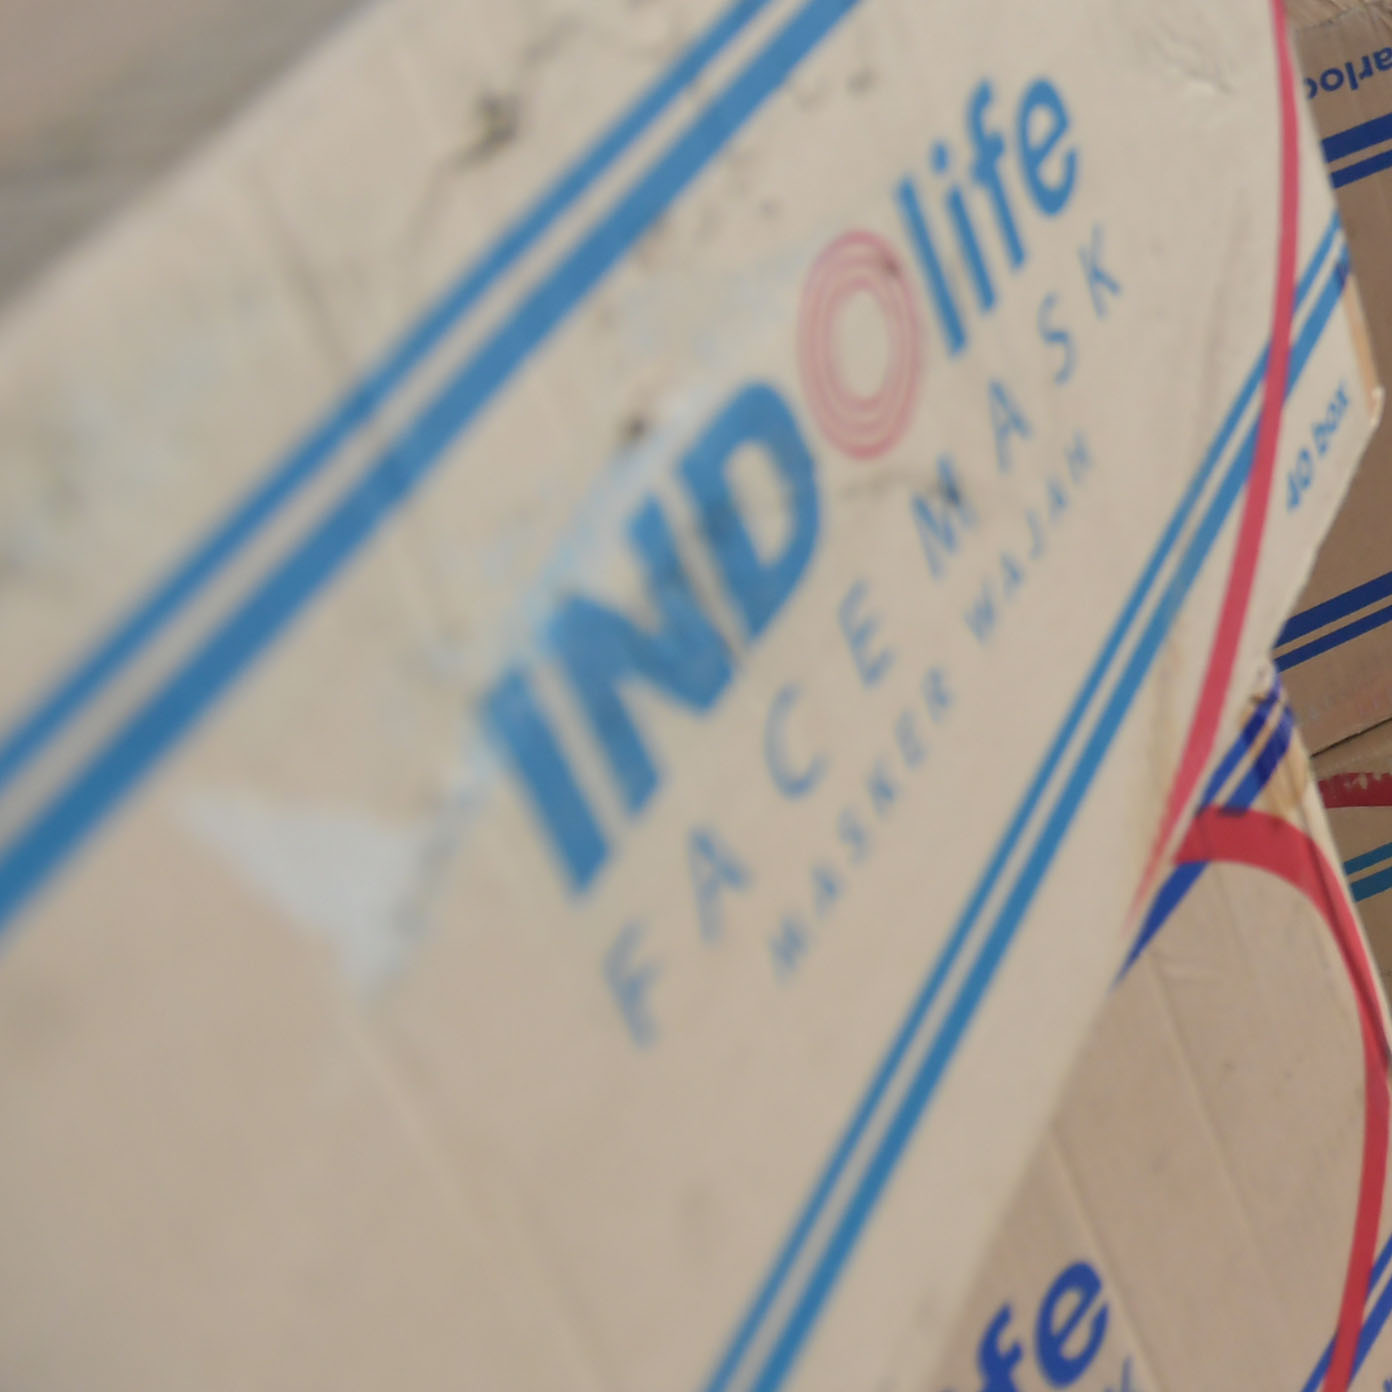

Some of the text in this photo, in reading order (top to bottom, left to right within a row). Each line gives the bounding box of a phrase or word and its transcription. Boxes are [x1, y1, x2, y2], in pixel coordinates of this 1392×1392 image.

[480, 74, 1080, 898] INDOlife
[601, 220, 1128, 1048] FACE MASK
[766, 432, 1098, 984] MASKER WAJAH
[1285, 378, 1351, 515] 40 box
